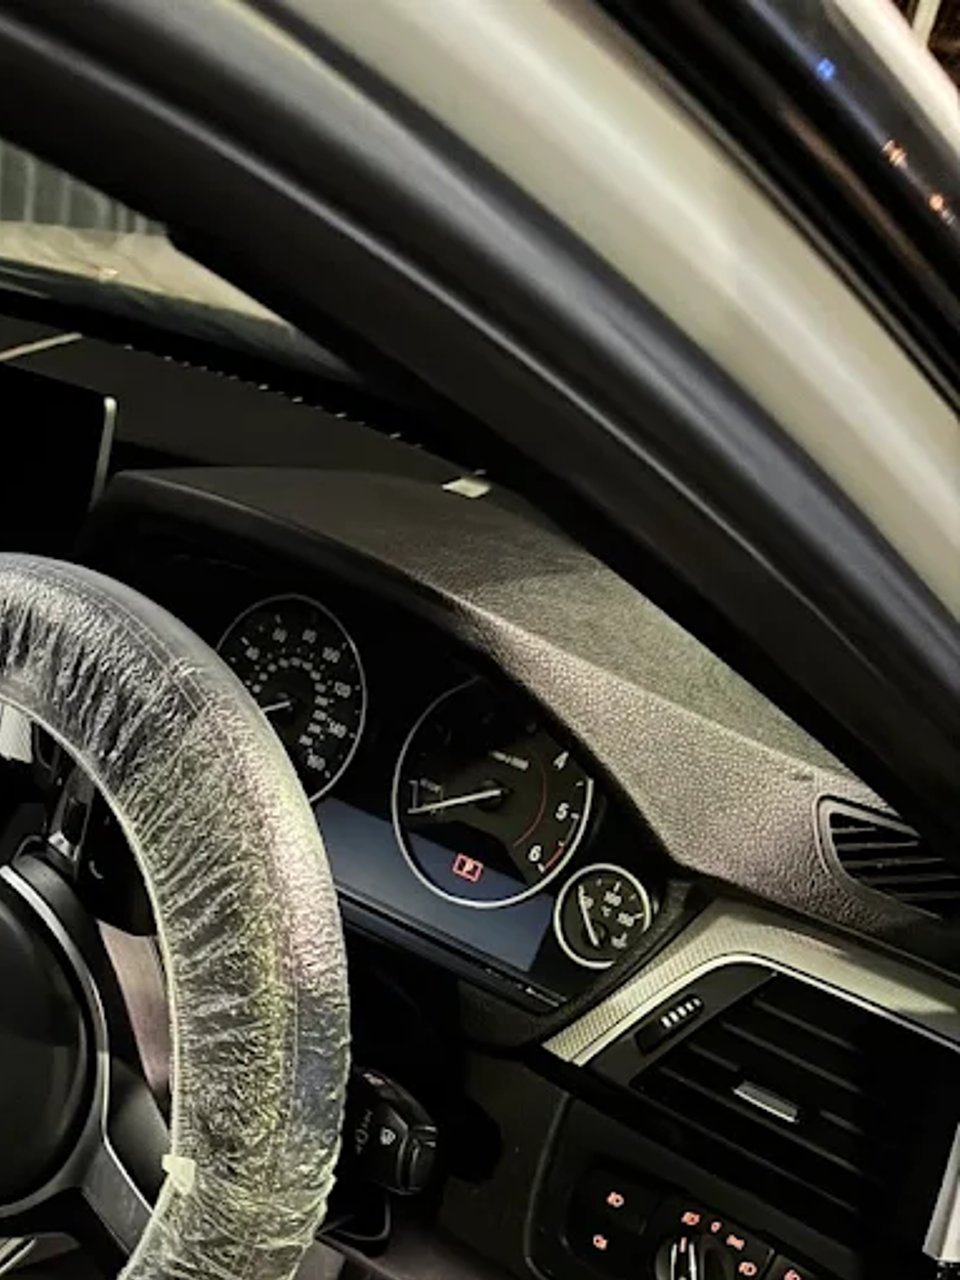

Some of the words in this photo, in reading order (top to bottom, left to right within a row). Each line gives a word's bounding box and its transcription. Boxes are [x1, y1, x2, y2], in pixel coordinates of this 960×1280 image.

[553, 751, 569, 770] 4
[555, 803, 570, 820] 5
[528, 845, 541, 862] 6
